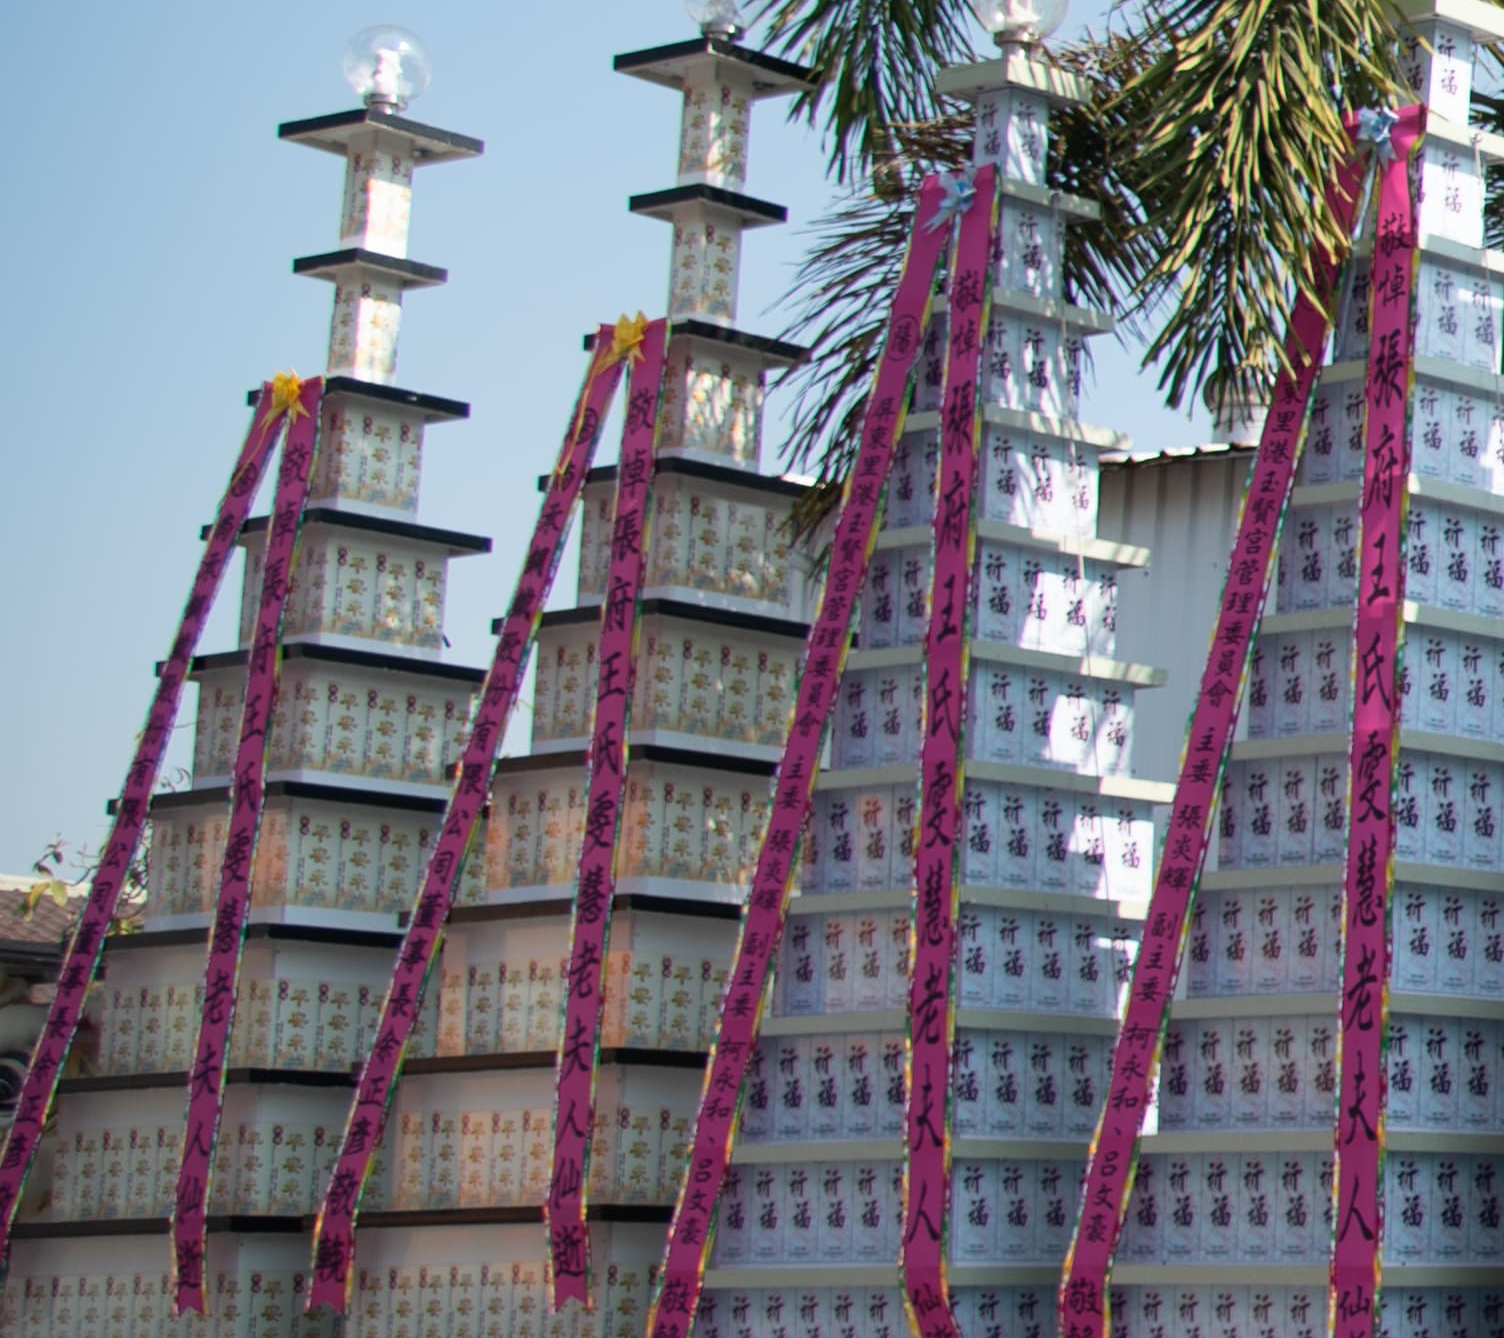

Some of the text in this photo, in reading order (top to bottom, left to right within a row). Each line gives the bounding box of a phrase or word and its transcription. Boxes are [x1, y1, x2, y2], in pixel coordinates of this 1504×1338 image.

[1247, 770, 1271, 837] 祈福
[1223, 900, 1245, 961] 祈福
[1259, 899, 1281, 959] 祈福
[1200, 1029, 1224, 1097] 祈福
[1169, 1160, 1193, 1227] 祈福
[1206, 1160, 1230, 1227] 祈福
[1243, 1160, 1267, 1227] 祈福
[1282, 1160, 1306, 1227] 祈福
